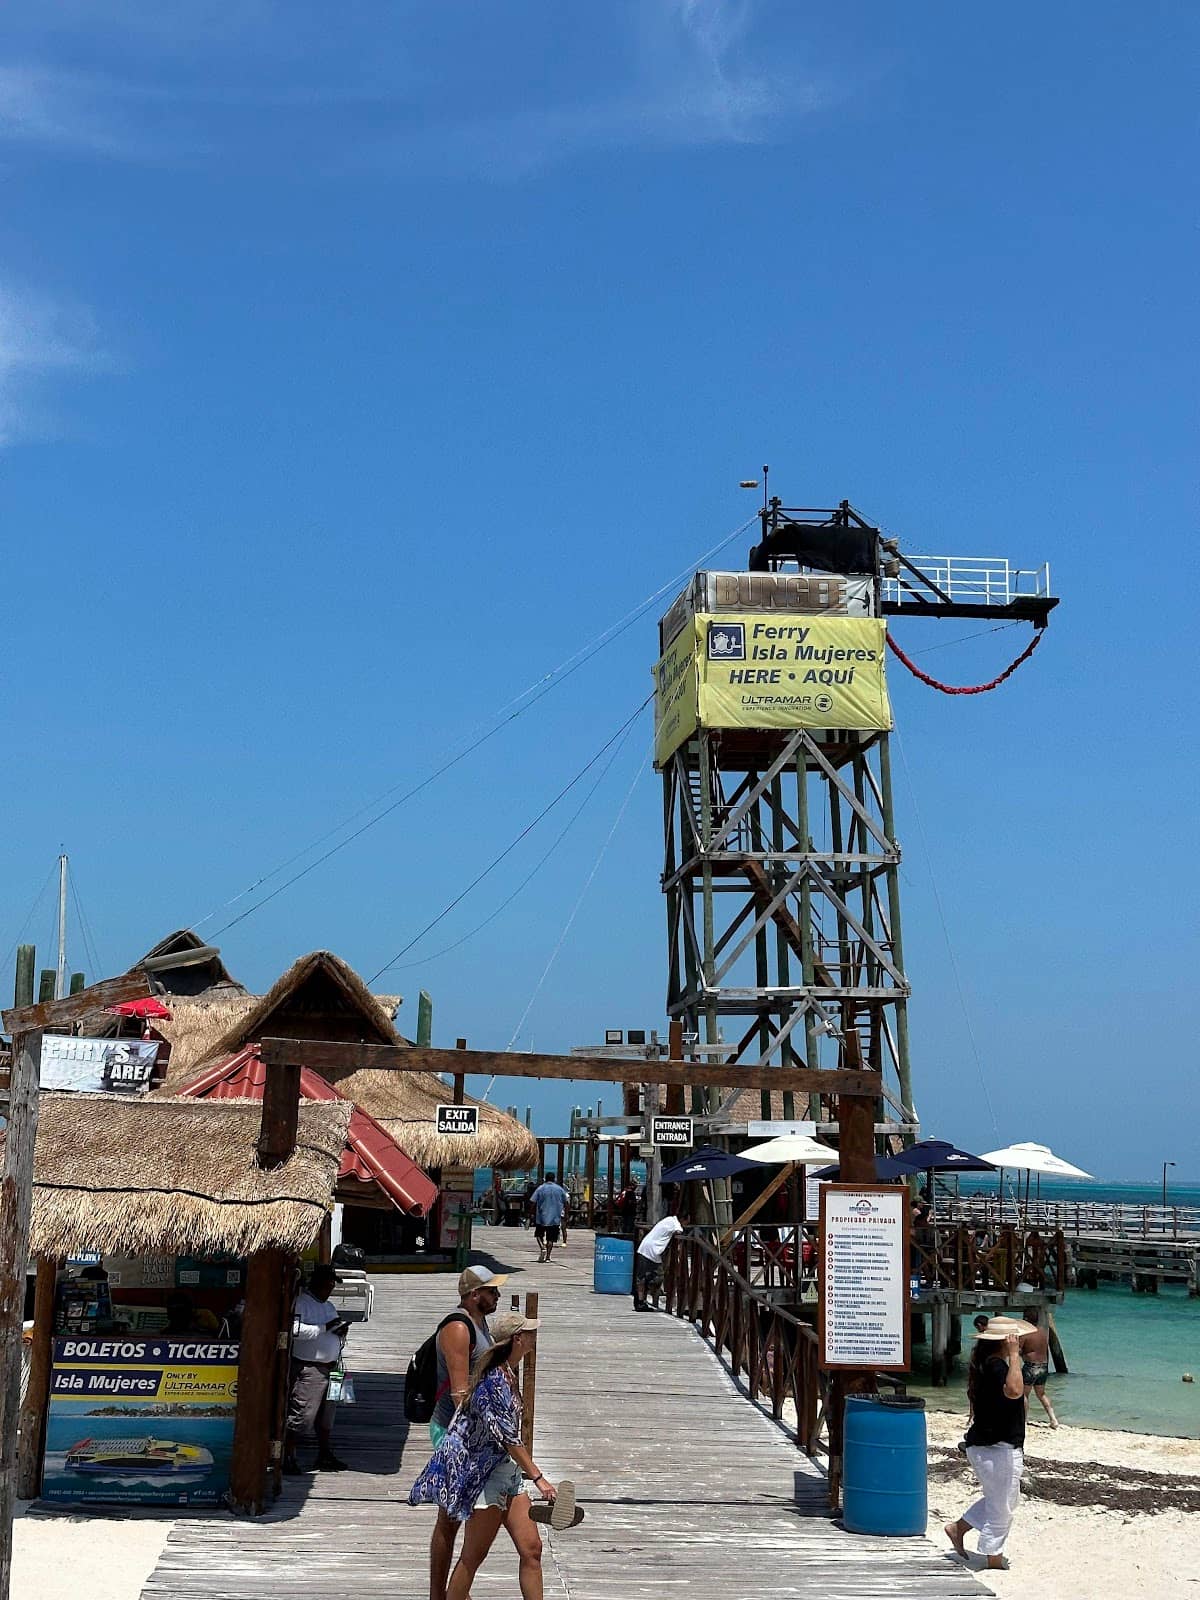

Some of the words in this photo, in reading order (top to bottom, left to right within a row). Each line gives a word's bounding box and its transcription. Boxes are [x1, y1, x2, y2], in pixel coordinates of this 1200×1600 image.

[715, 575, 848, 609] BUNGEE
[752, 623, 811, 644] Ferry
[752, 644, 788, 661] Isla
[794, 645, 877, 665] Mujeres
[729, 669, 782, 685] HERE
[802, 666, 856, 687] AQUÍ
[741, 695, 812, 705] ULTRAMAR
[42, 1040, 131, 1063] ERRY'S
[445, 1109, 470, 1120] EXIT
[438, 1121, 475, 1132] SALIDA
[655, 1121, 690, 1131] ENTRANCE
[656, 1132, 688, 1142] ENTRADA
[63, 1341, 146, 1358] BOLETOS
[168, 1343, 240, 1360] TICKETS
[55, 1374, 84, 1390] Isla
[88, 1375, 156, 1393] Mujeres
[164, 1381, 226, 1390] ULTRAMAR
